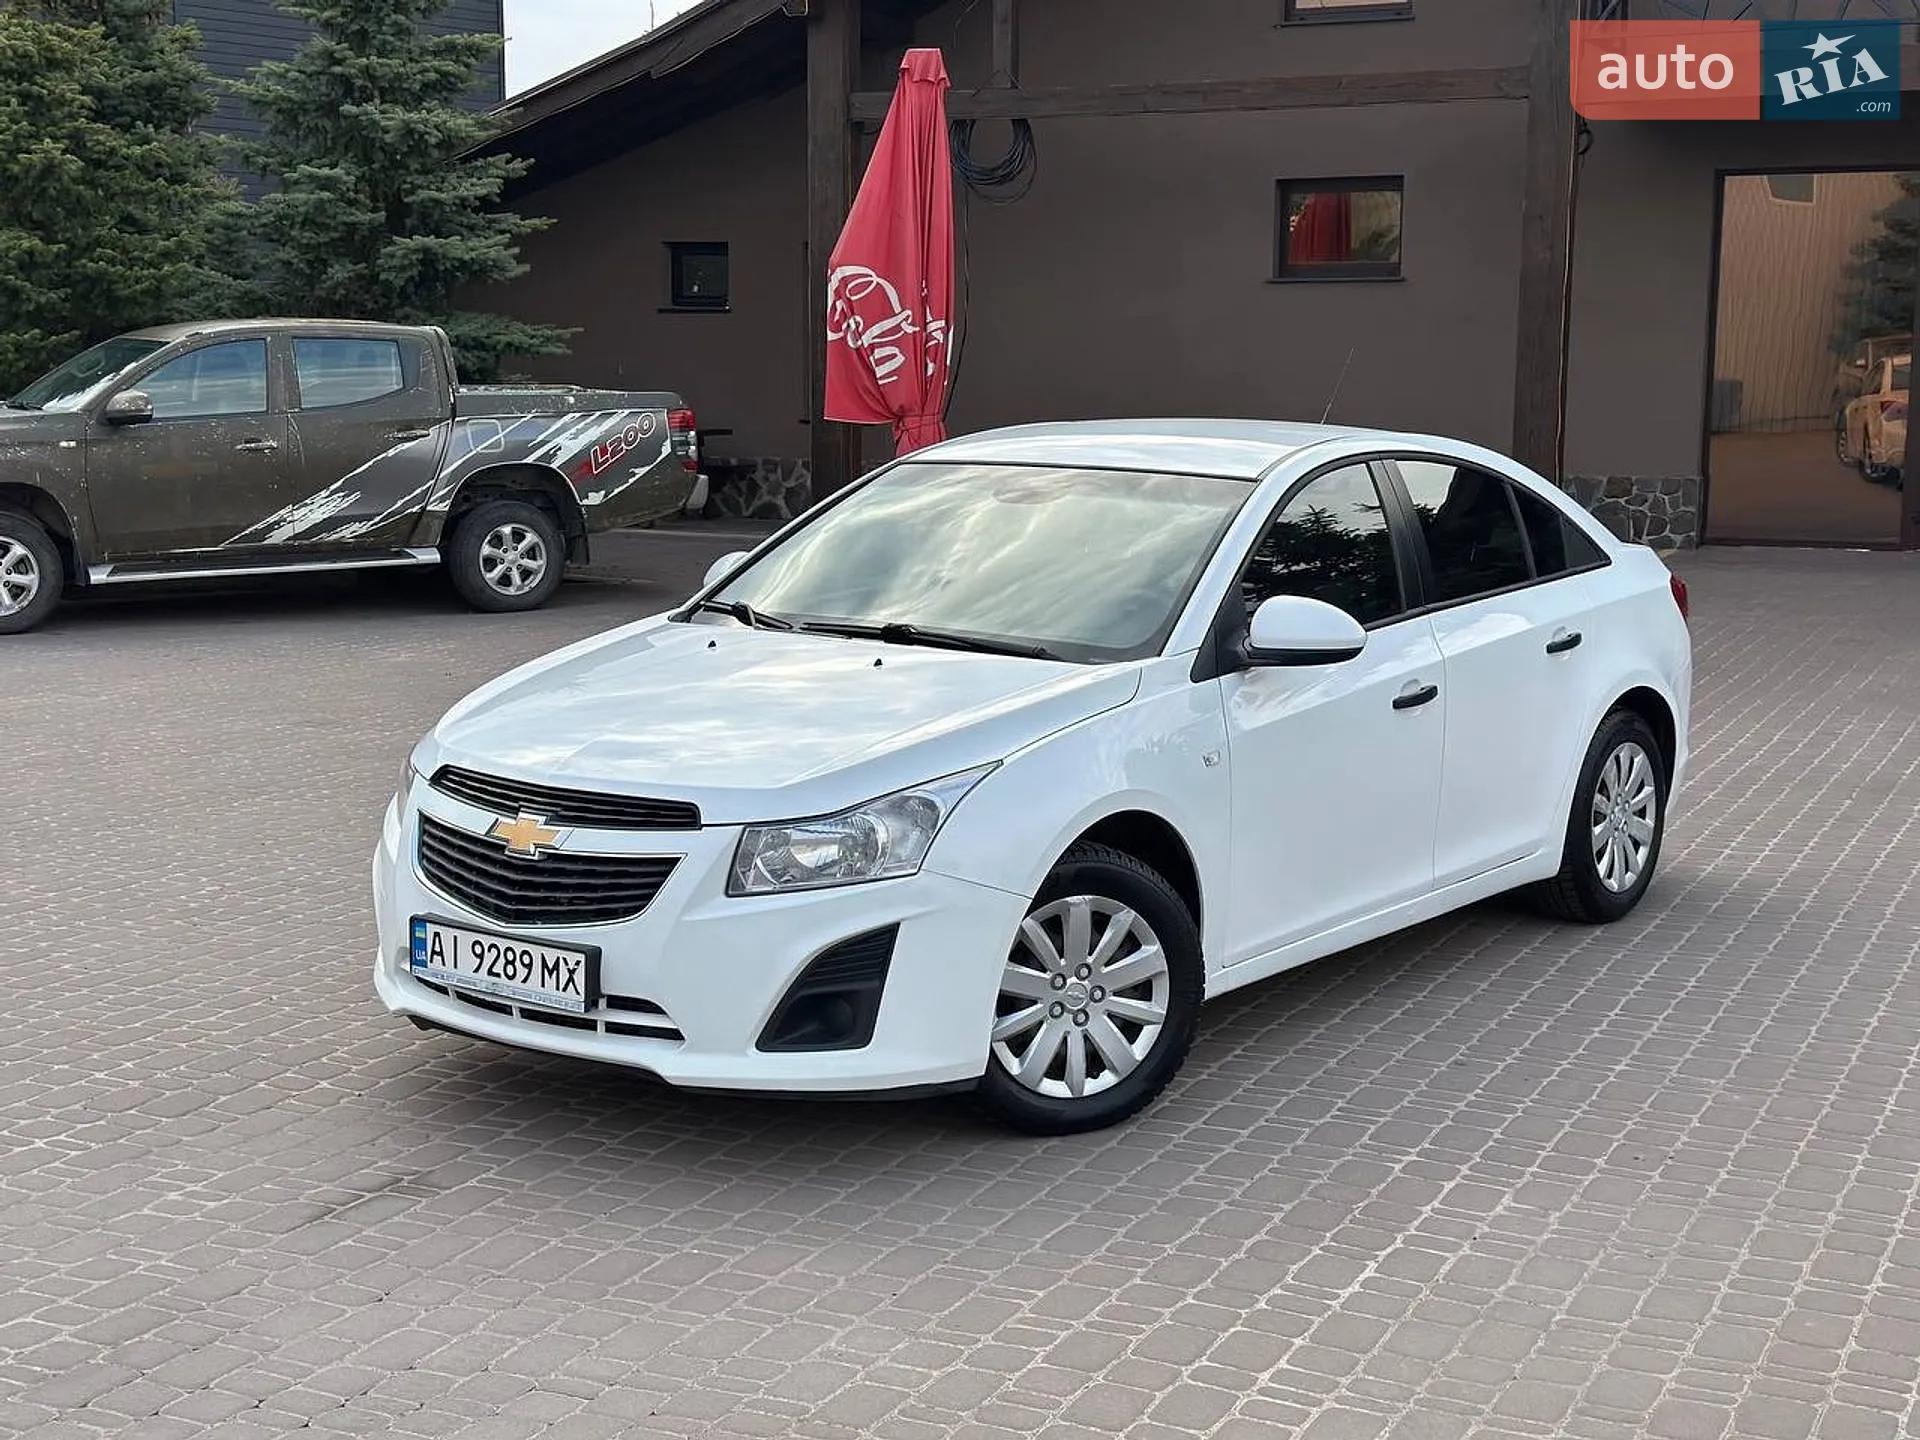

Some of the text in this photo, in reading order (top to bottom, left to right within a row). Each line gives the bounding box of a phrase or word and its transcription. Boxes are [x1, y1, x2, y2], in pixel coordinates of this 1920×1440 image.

[590, 412, 657, 475] L200
[415, 949, 427, 960] UA
[429, 931, 458, 969] AI
[471, 939, 534, 984] 9289
[540, 952, 582, 996] MX
